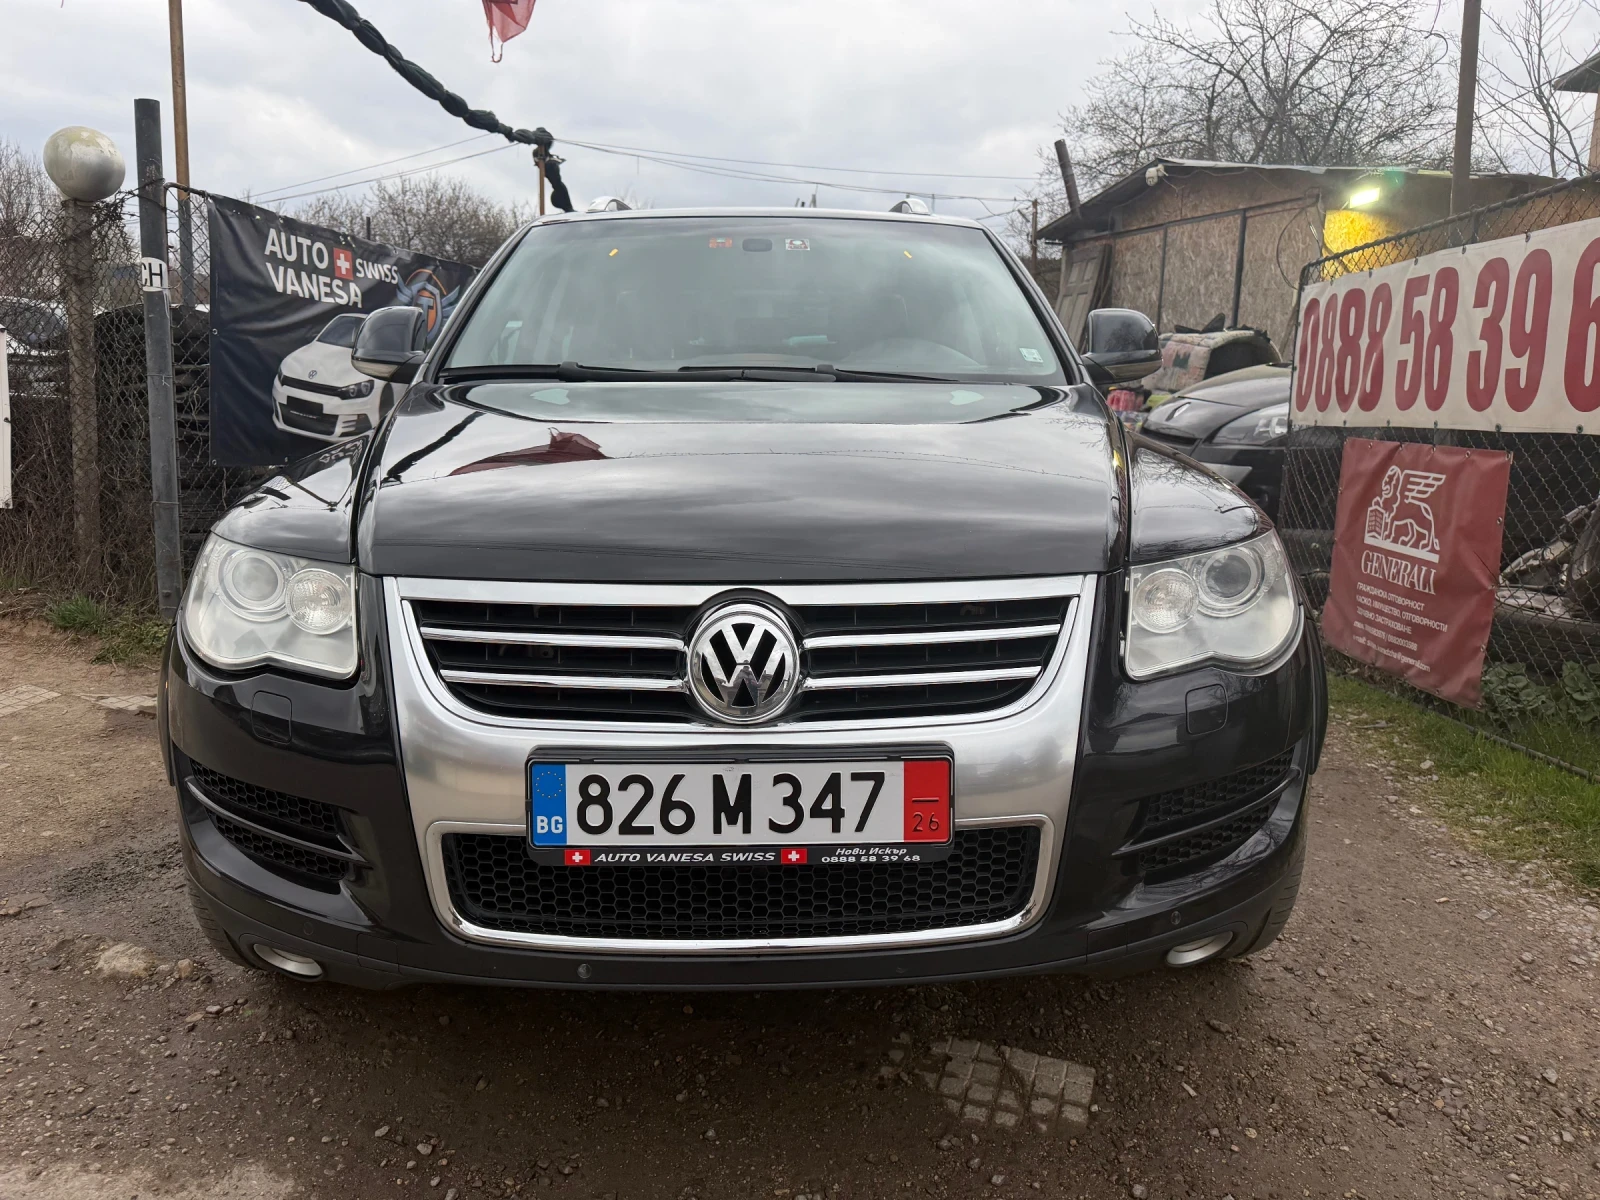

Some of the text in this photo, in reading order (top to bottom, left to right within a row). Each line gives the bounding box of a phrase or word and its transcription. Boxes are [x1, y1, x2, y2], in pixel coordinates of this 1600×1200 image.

[264, 228, 399, 285] AUTO SWISS
[265, 262, 363, 309] VANESA
[1295, 282, 1392, 413] 0888
[1395, 267, 1459, 412] 58
[1466, 248, 1553, 413] 39
[1361, 549, 1437, 595] GENERALI
[1387, 592, 1425, 611] ОТГОВОРНОСТ
[1401, 610, 1448, 632] ОТГОВОРНОСТИ
[576, 771, 886, 835] 826 M 347
[536, 815, 564, 834] BG
[911, 811, 940, 833] 26
[594, 852, 776, 862] AUTO VANESA SWISS
[835, 847, 908, 856] Нови Искър
[903, 854, 921, 862] 68
